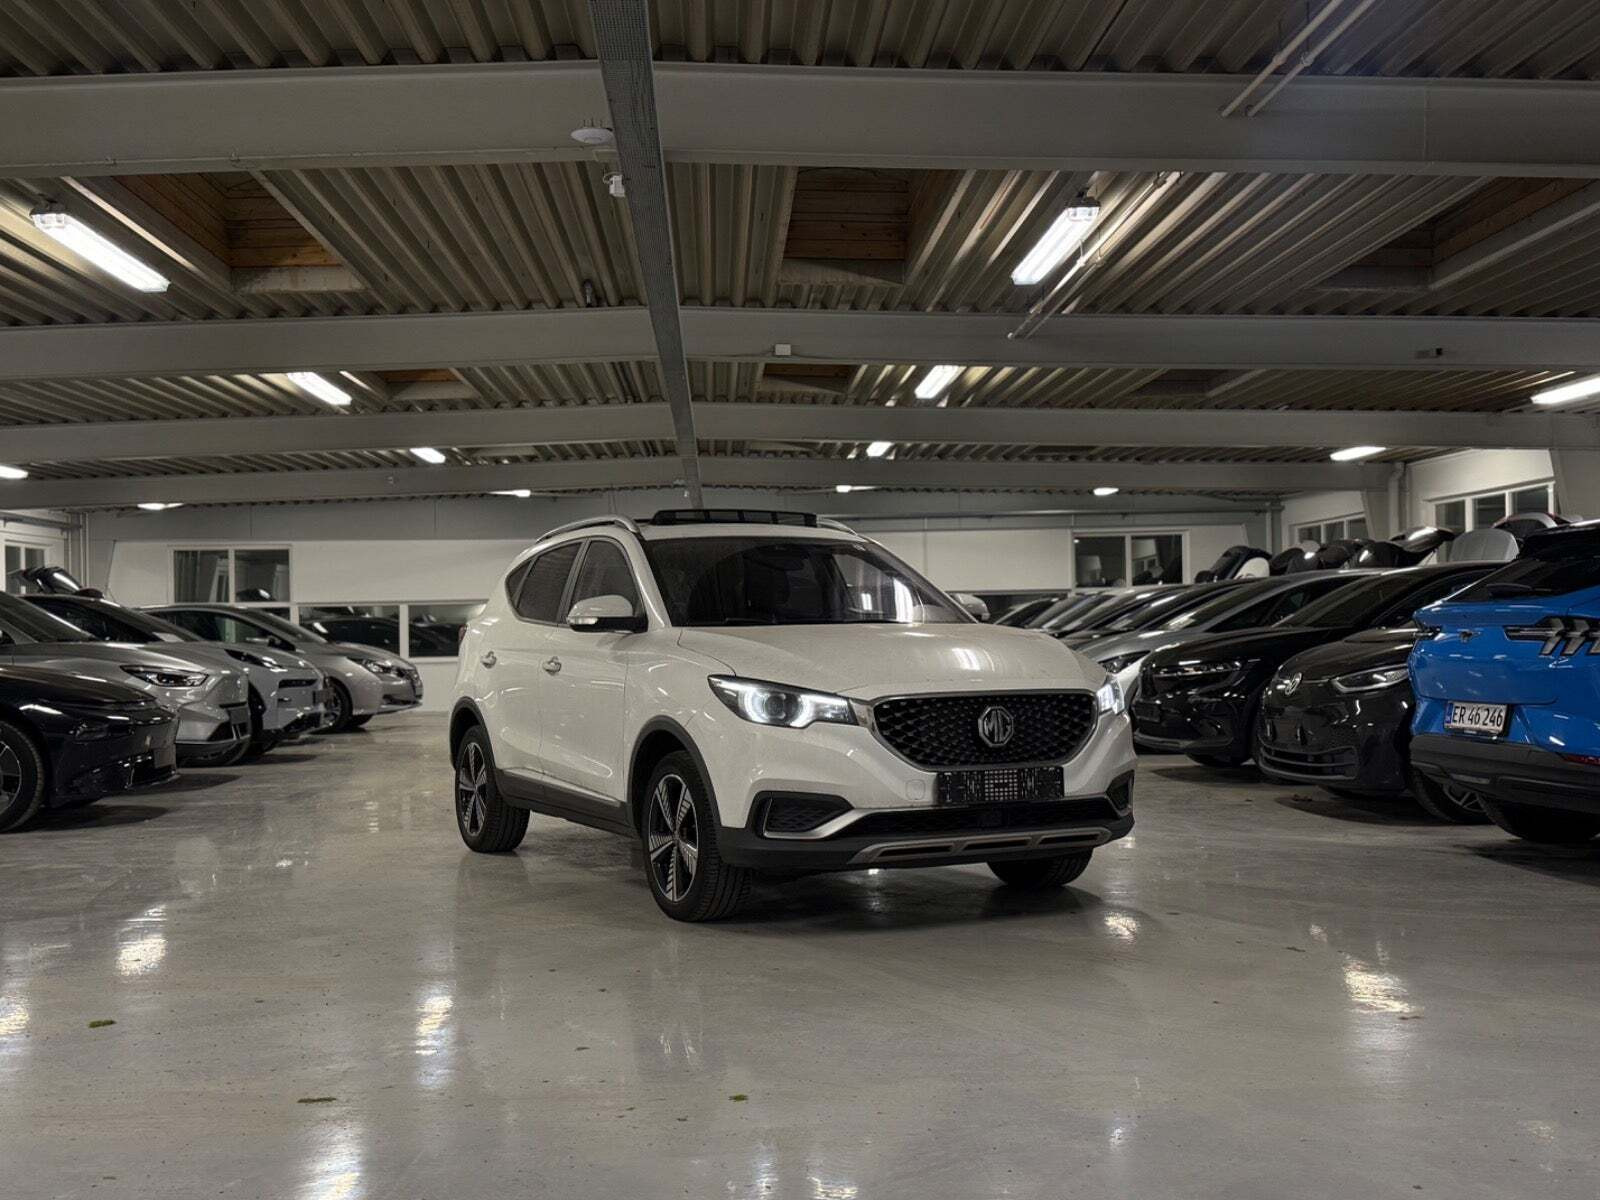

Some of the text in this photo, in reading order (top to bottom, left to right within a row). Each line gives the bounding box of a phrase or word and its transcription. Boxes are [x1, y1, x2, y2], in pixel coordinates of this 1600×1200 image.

[982, 708, 1012, 743] MG
[1452, 705, 1504, 728] ER 46 246
